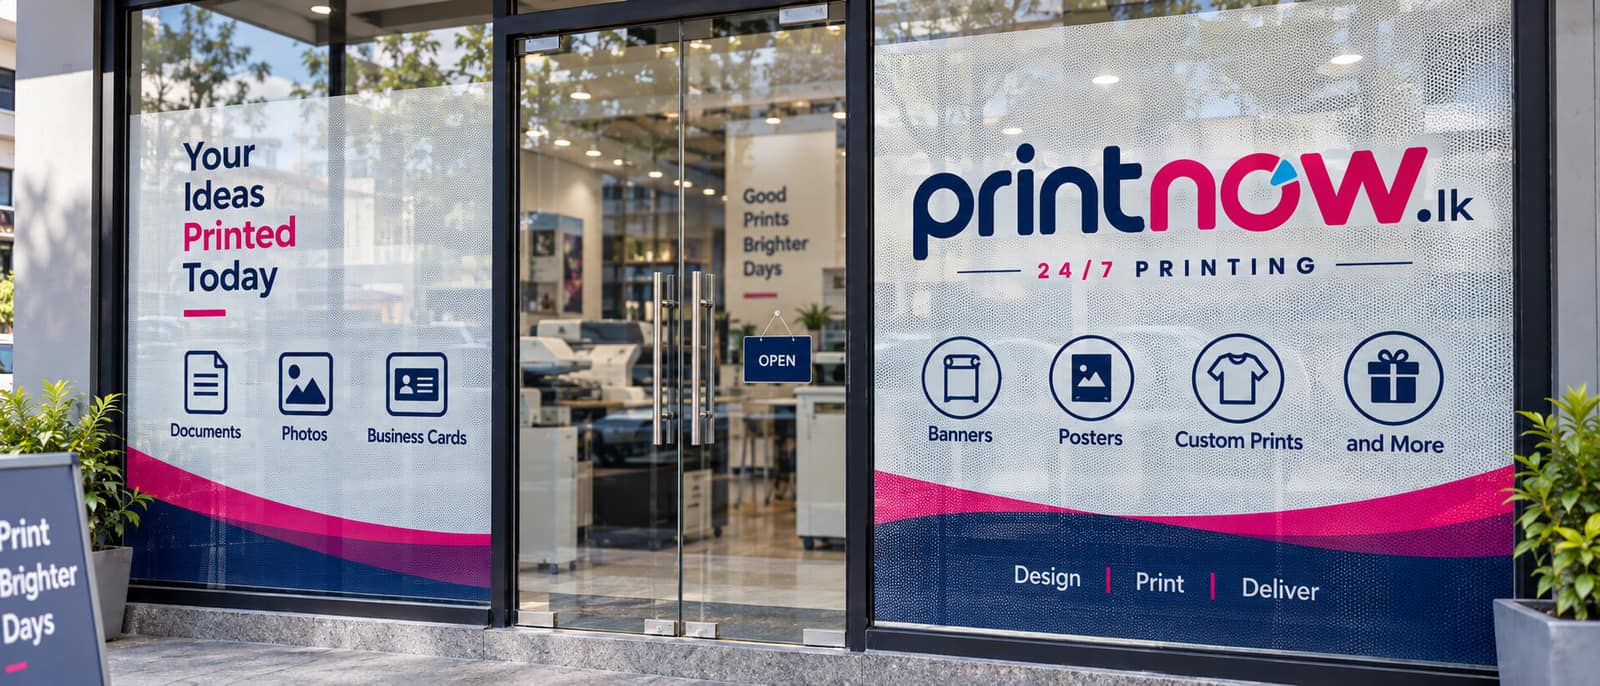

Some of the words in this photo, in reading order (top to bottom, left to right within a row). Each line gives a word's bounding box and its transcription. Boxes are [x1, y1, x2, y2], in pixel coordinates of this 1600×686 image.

[183, 142, 255, 171] Your
[184, 180, 265, 211] Ideas
[743, 187, 787, 205] Good
[913, 143, 1474, 260] printnow.lk
[743, 210, 789, 228] Prints
[183, 215, 297, 251] Printed
[743, 235, 808, 256] Brighter
[743, 260, 783, 280] Days
[1037, 260, 1115, 279] 24/7
[1136, 257, 1317, 277] PRINTING
[183, 260, 278, 298] Today
[758, 354, 796, 368] OPEN
[170, 423, 241, 440] Documents
[281, 425, 328, 442] Photos
[367, 427, 424, 445] Business
[427, 429, 467, 446] Cards
[928, 425, 993, 443] Banners
[1058, 428, 1123, 446] Posters
[1175, 430, 1246, 449] Custom
[1250, 431, 1304, 450] Prints
[1346, 434, 1386, 453] and
[1390, 434, 1445, 454] More
[0, 518, 51, 549] Print
[0, 562, 78, 600] Brighter
[1014, 564, 1082, 589] Design
[1136, 571, 1185, 594] Print
[1242, 577, 1320, 600] Deliver
[2, 613, 56, 646] Days
